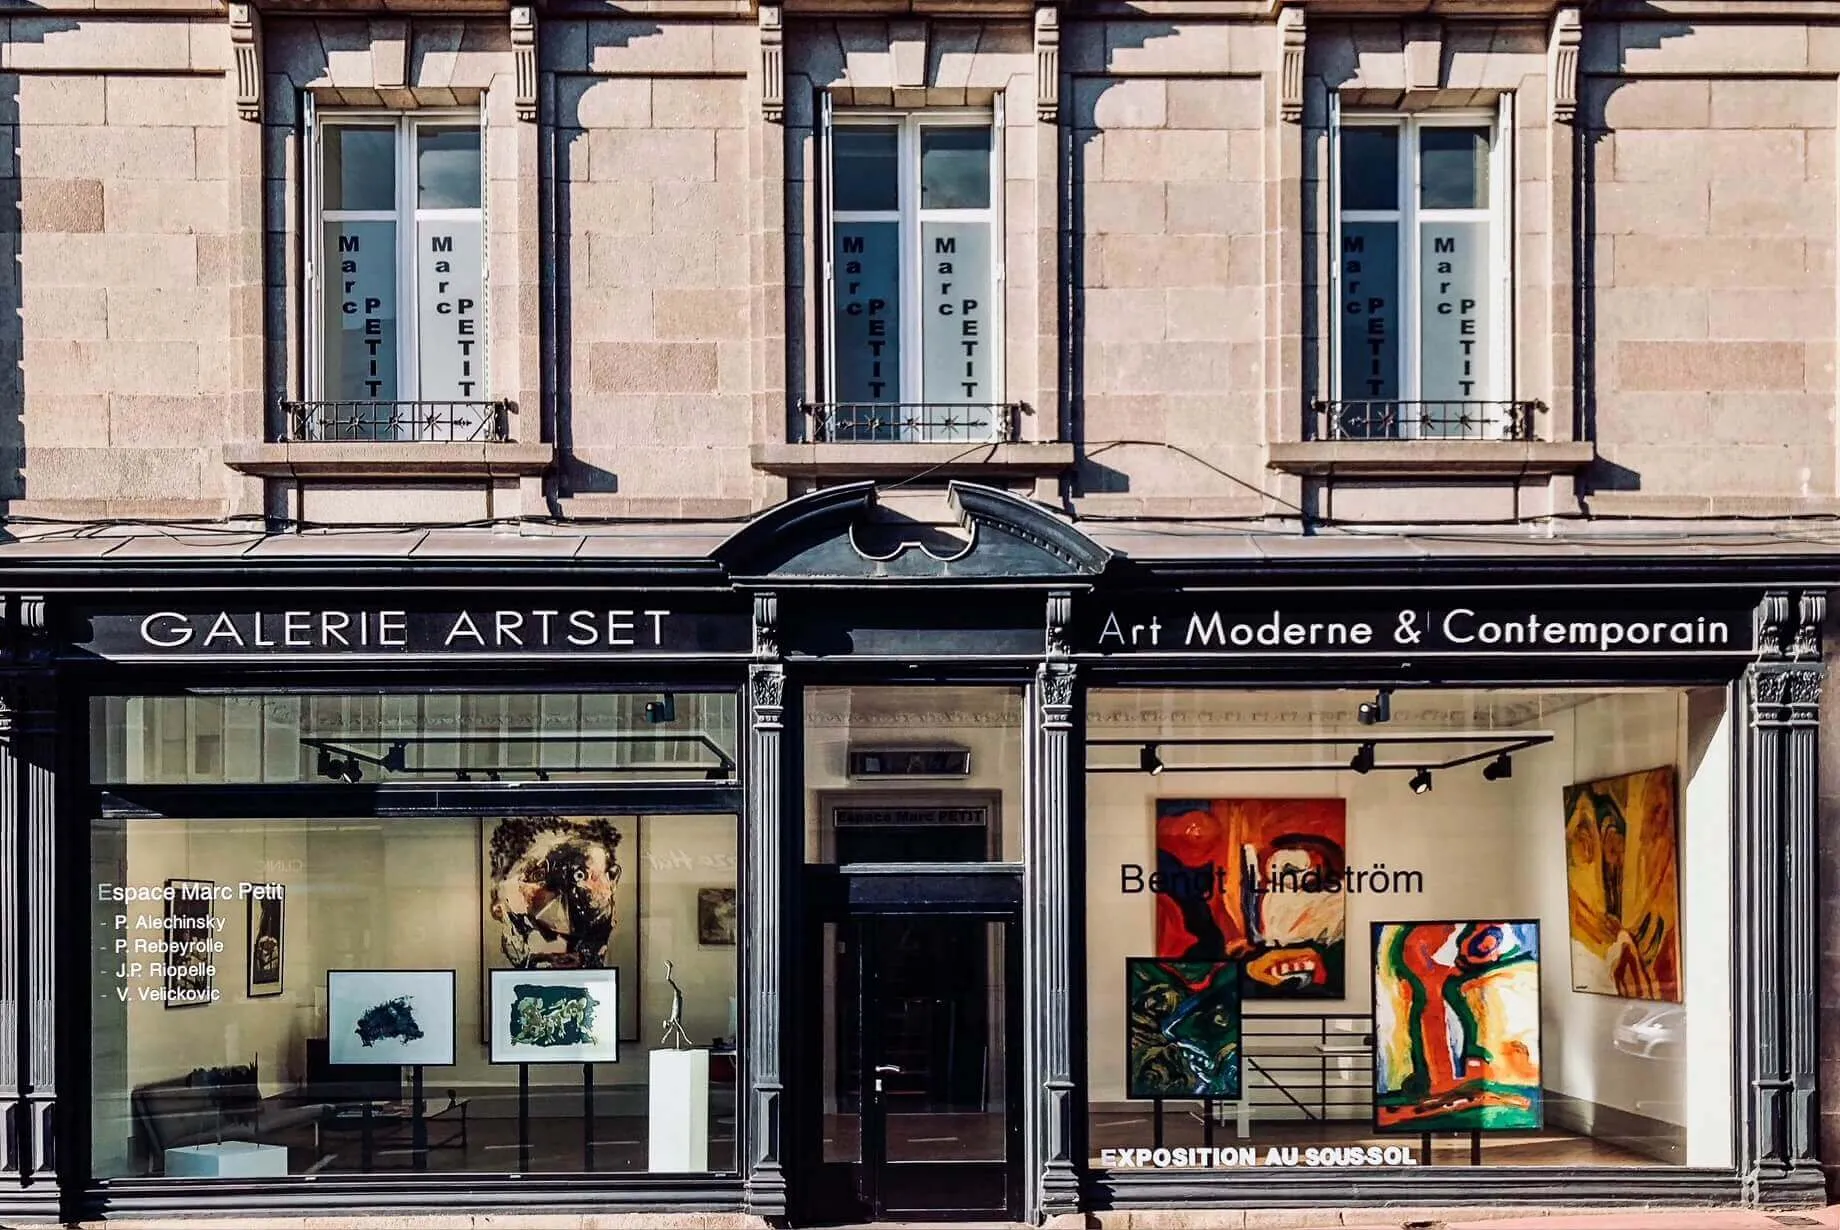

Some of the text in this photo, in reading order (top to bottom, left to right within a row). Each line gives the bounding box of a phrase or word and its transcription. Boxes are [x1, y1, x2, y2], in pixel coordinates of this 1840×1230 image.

[338, 236, 382, 397] Marc PETIT
[431, 236, 475, 397] Marc PETIT
[842, 236, 886, 398] Marc PETIT
[935, 237, 978, 398] Marc PETIT
[1343, 236, 1385, 396] Marc PETIT
[1434, 237, 1476, 396] Marc PETIT
[140, 610, 671, 647] GALERIE ARTSET
[1098, 608, 1728, 652] Art Moderne & Contemporain
[938, 809, 982, 823] PETIT
[98, 882, 283, 905] Espace Marc Petit
[1121, 863, 1423, 900] Bengt Lindström
[115, 915, 129, 930] P.
[136, 914, 226, 932] Alechinsky
[115, 939, 129, 954] P.
[135, 938, 224, 956] Rebeyrolle
[150, 962, 216, 980] Riopelle
[116, 987, 131, 1001] V.
[138, 986, 221, 1001] Velickovic
[1100, 1146, 1417, 1167] EXPOSITION AU SOUS-SOL
